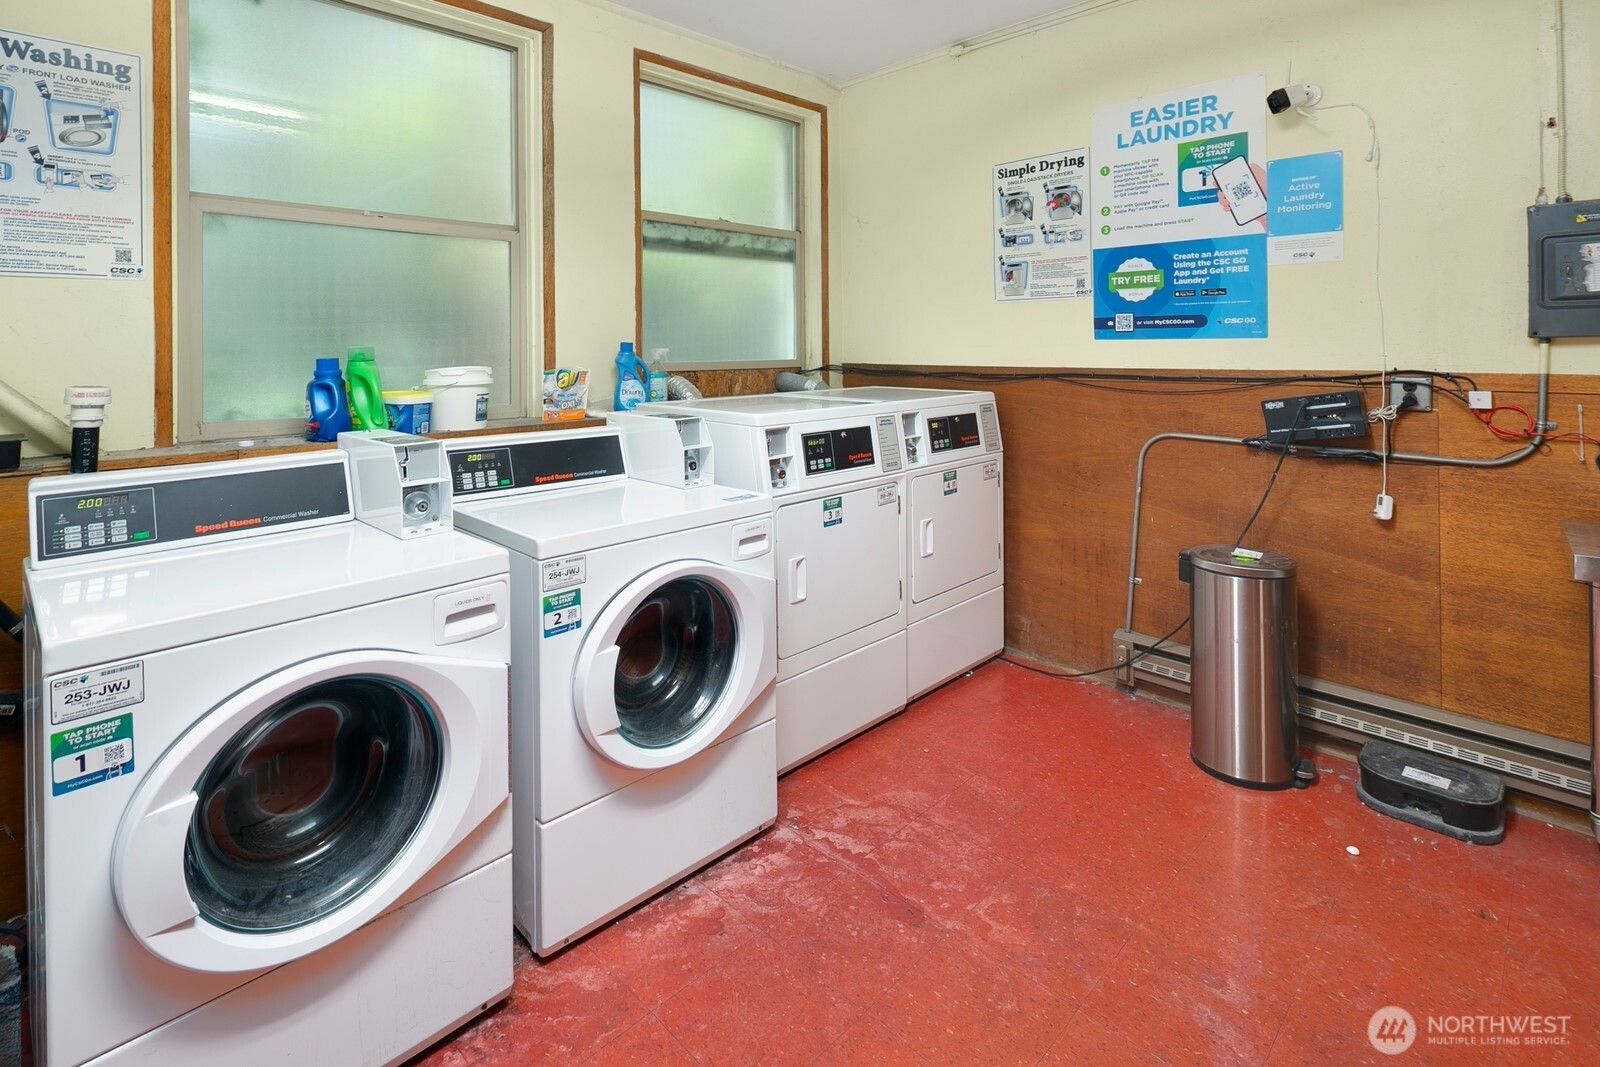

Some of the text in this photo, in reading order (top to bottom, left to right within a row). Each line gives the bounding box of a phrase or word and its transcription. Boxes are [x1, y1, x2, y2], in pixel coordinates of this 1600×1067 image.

[0, 36, 131, 84] Washing
[22, 67, 57, 79] FRONT
[60, 73, 88, 85] LOAD
[90, 79, 131, 92] WASHER
[1130, 94, 1218, 128] EASIER
[1117, 111, 1234, 149] LAUNDRY
[1190, 141, 1235, 154] TAP PHONE
[1205, 147, 1232, 158] START
[997, 163, 1036, 180] Simple
[1039, 156, 1085, 172] Drying
[1053, 170, 1074, 178] DRYERS
[1102, 167, 1108, 175] 1
[1198, 169, 1207, 187] 1
[1288, 182, 1321, 192] Active
[1283, 192, 1325, 203] Laundry
[1277, 201, 1332, 213] Monitoring
[1103, 226, 1109, 234] 3
[1173, 252, 1200, 260] Create
[1213, 248, 1249, 257] Account
[1173, 261, 1196, 269] Using
[1197, 259, 1212, 267] the
[1232, 256, 1247, 264] GO
[1173, 269, 1190, 277] App
[1226, 265, 1250, 273] FREE
[1111, 274, 1161, 286] TRY FREE
[621, 387, 644, 397] Downy
[561, 399, 576, 409] OXI
[467, 453, 482, 462] 2.00
[534, 474, 555, 483] Speed
[555, 472, 574, 481] Queen
[573, 470, 595, 478] Commercial
[77, 497, 103, 509] 2.00
[194, 508, 320, 534] Speed Queen Commercial Washer
[828, 511, 833, 520] 3
[548, 566, 580, 580] 254-JWJ
[454, 598, 473, 607] LIQUIDS
[548, 591, 576, 604] TAP PHONE
[558, 597, 574, 606] START
[553, 612, 562, 625] 2
[54, 677, 78, 689] CSC
[64, 679, 131, 705] 253-JWJ
[63, 719, 122, 741] TAP PHONE
[68, 726, 118, 746] TO START
[74, 753, 86, 773] 1
